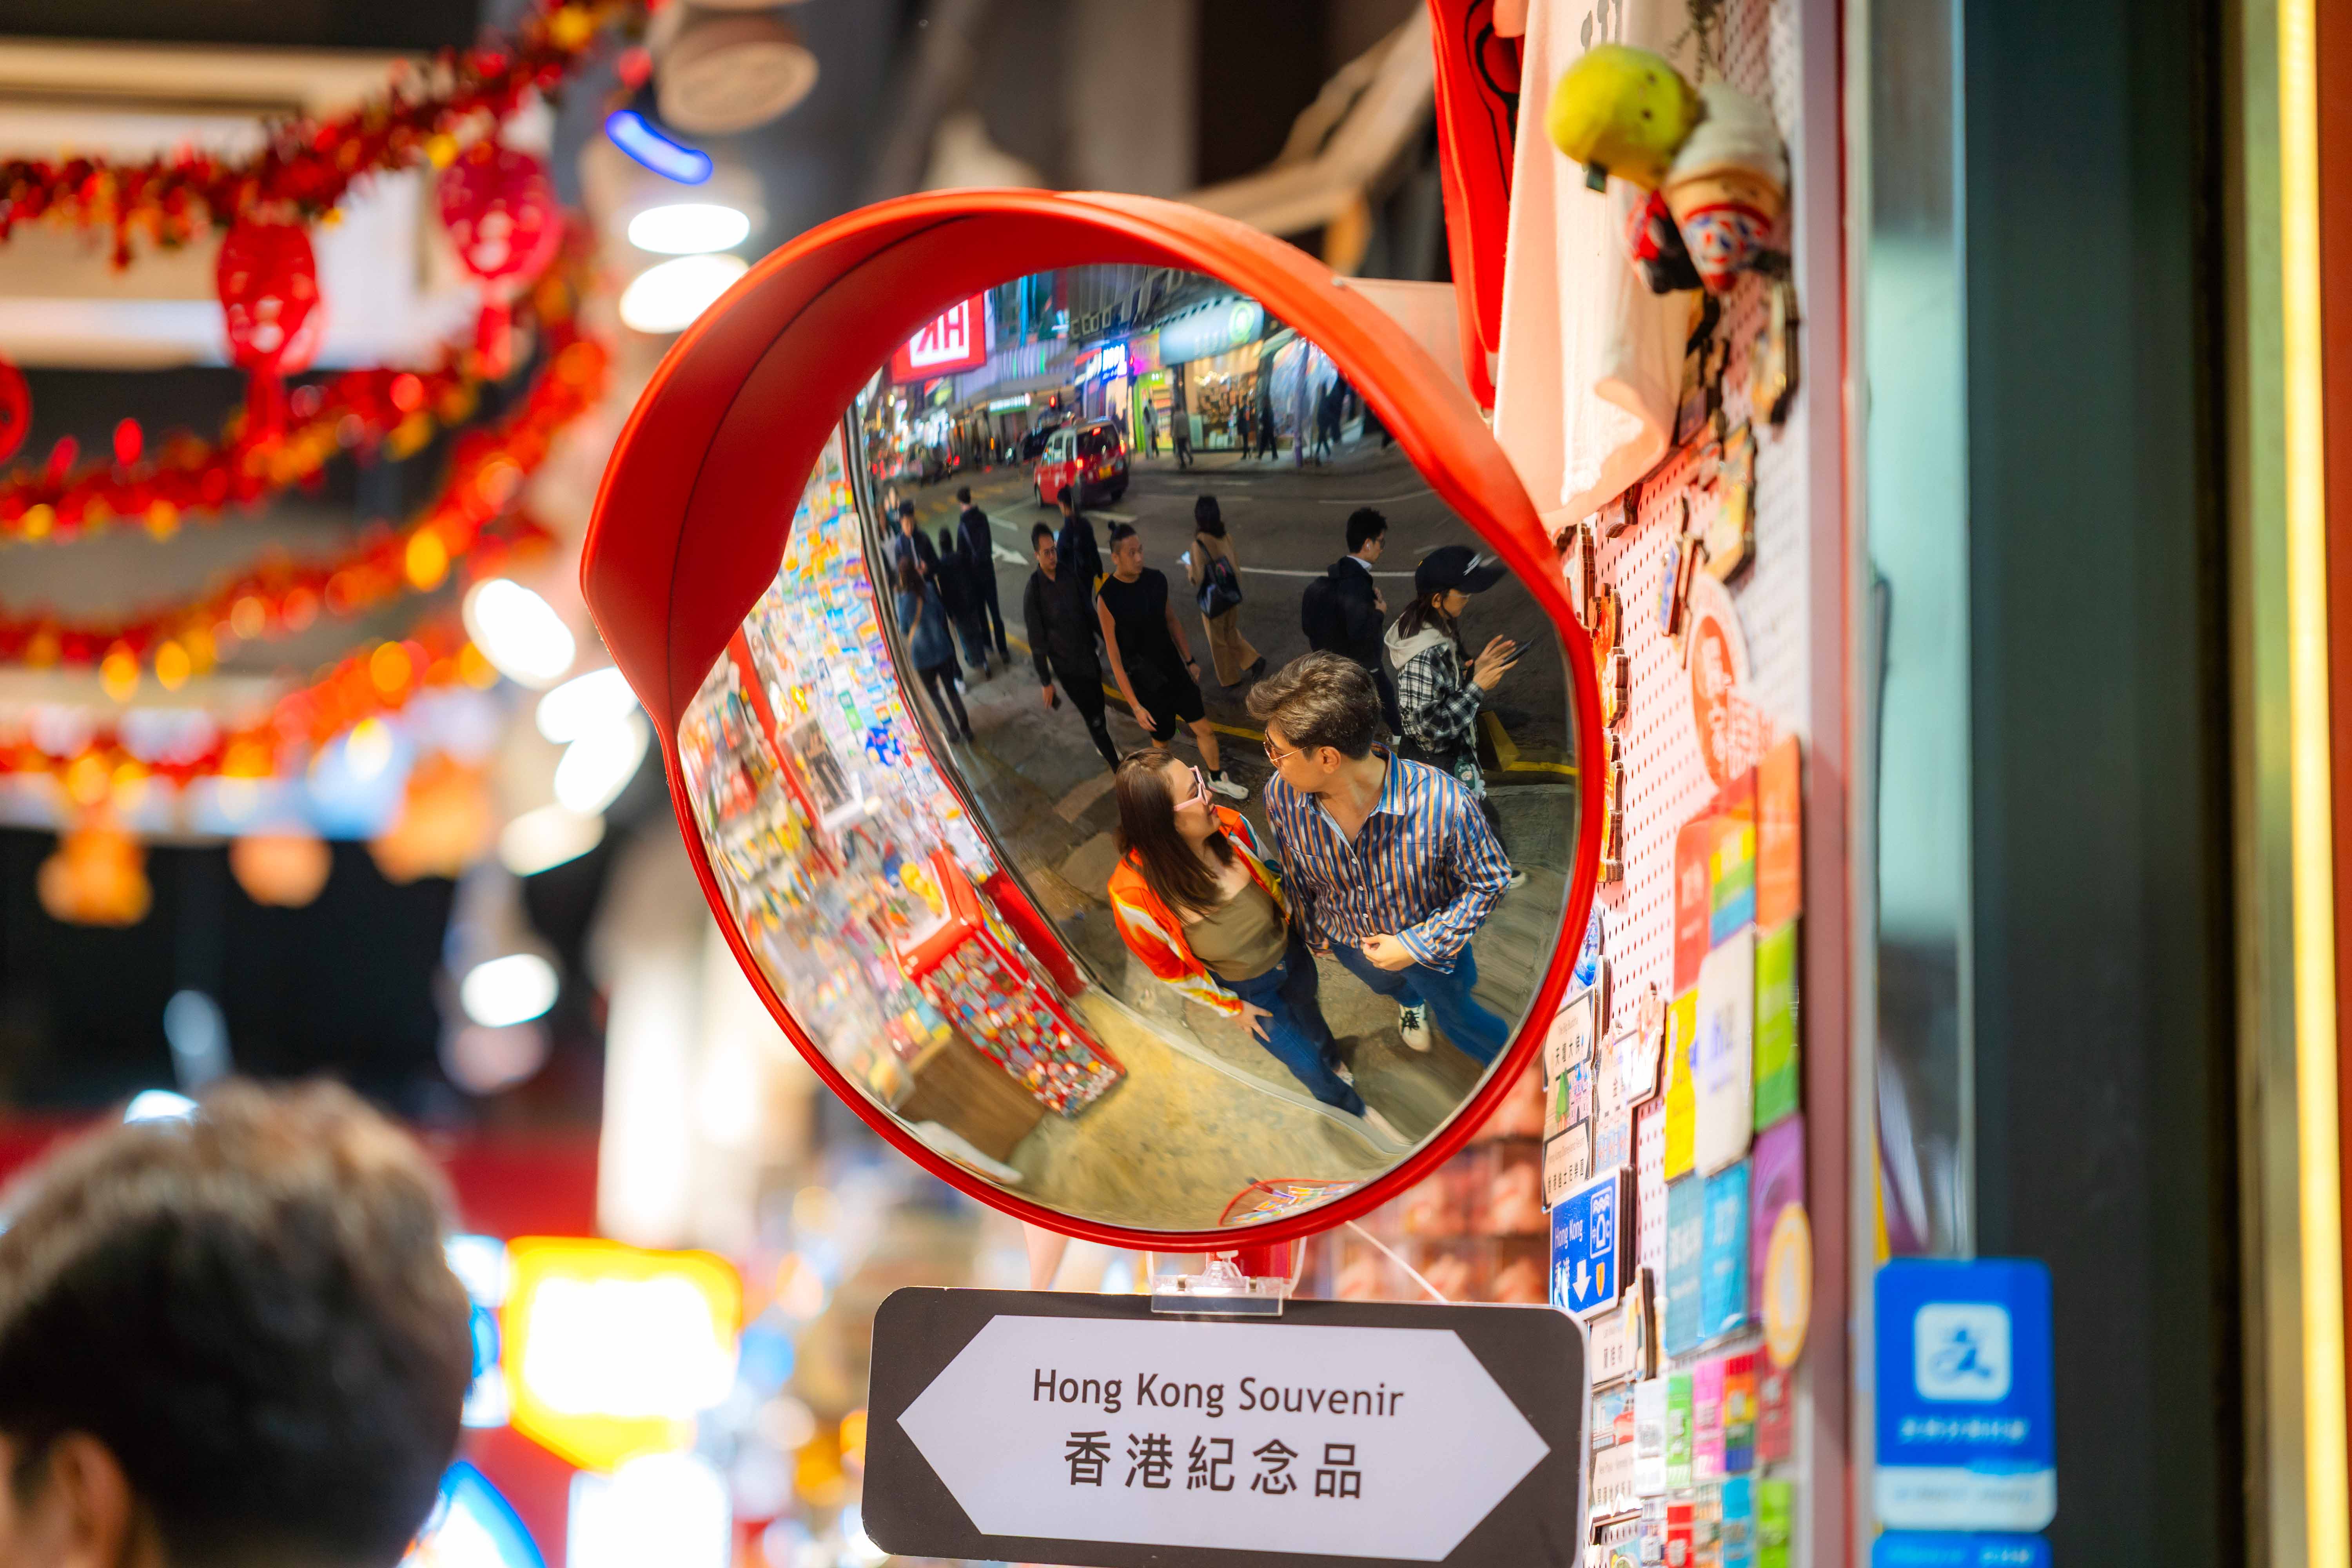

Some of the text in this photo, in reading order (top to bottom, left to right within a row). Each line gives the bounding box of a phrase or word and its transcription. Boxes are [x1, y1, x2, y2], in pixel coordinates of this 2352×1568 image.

[1554, 1219, 1583, 1250] Hong Kong
[1034, 1368, 1404, 1418] Hong Kong Souvenir
[1064, 1431, 1361, 1499] 香港紀念品
